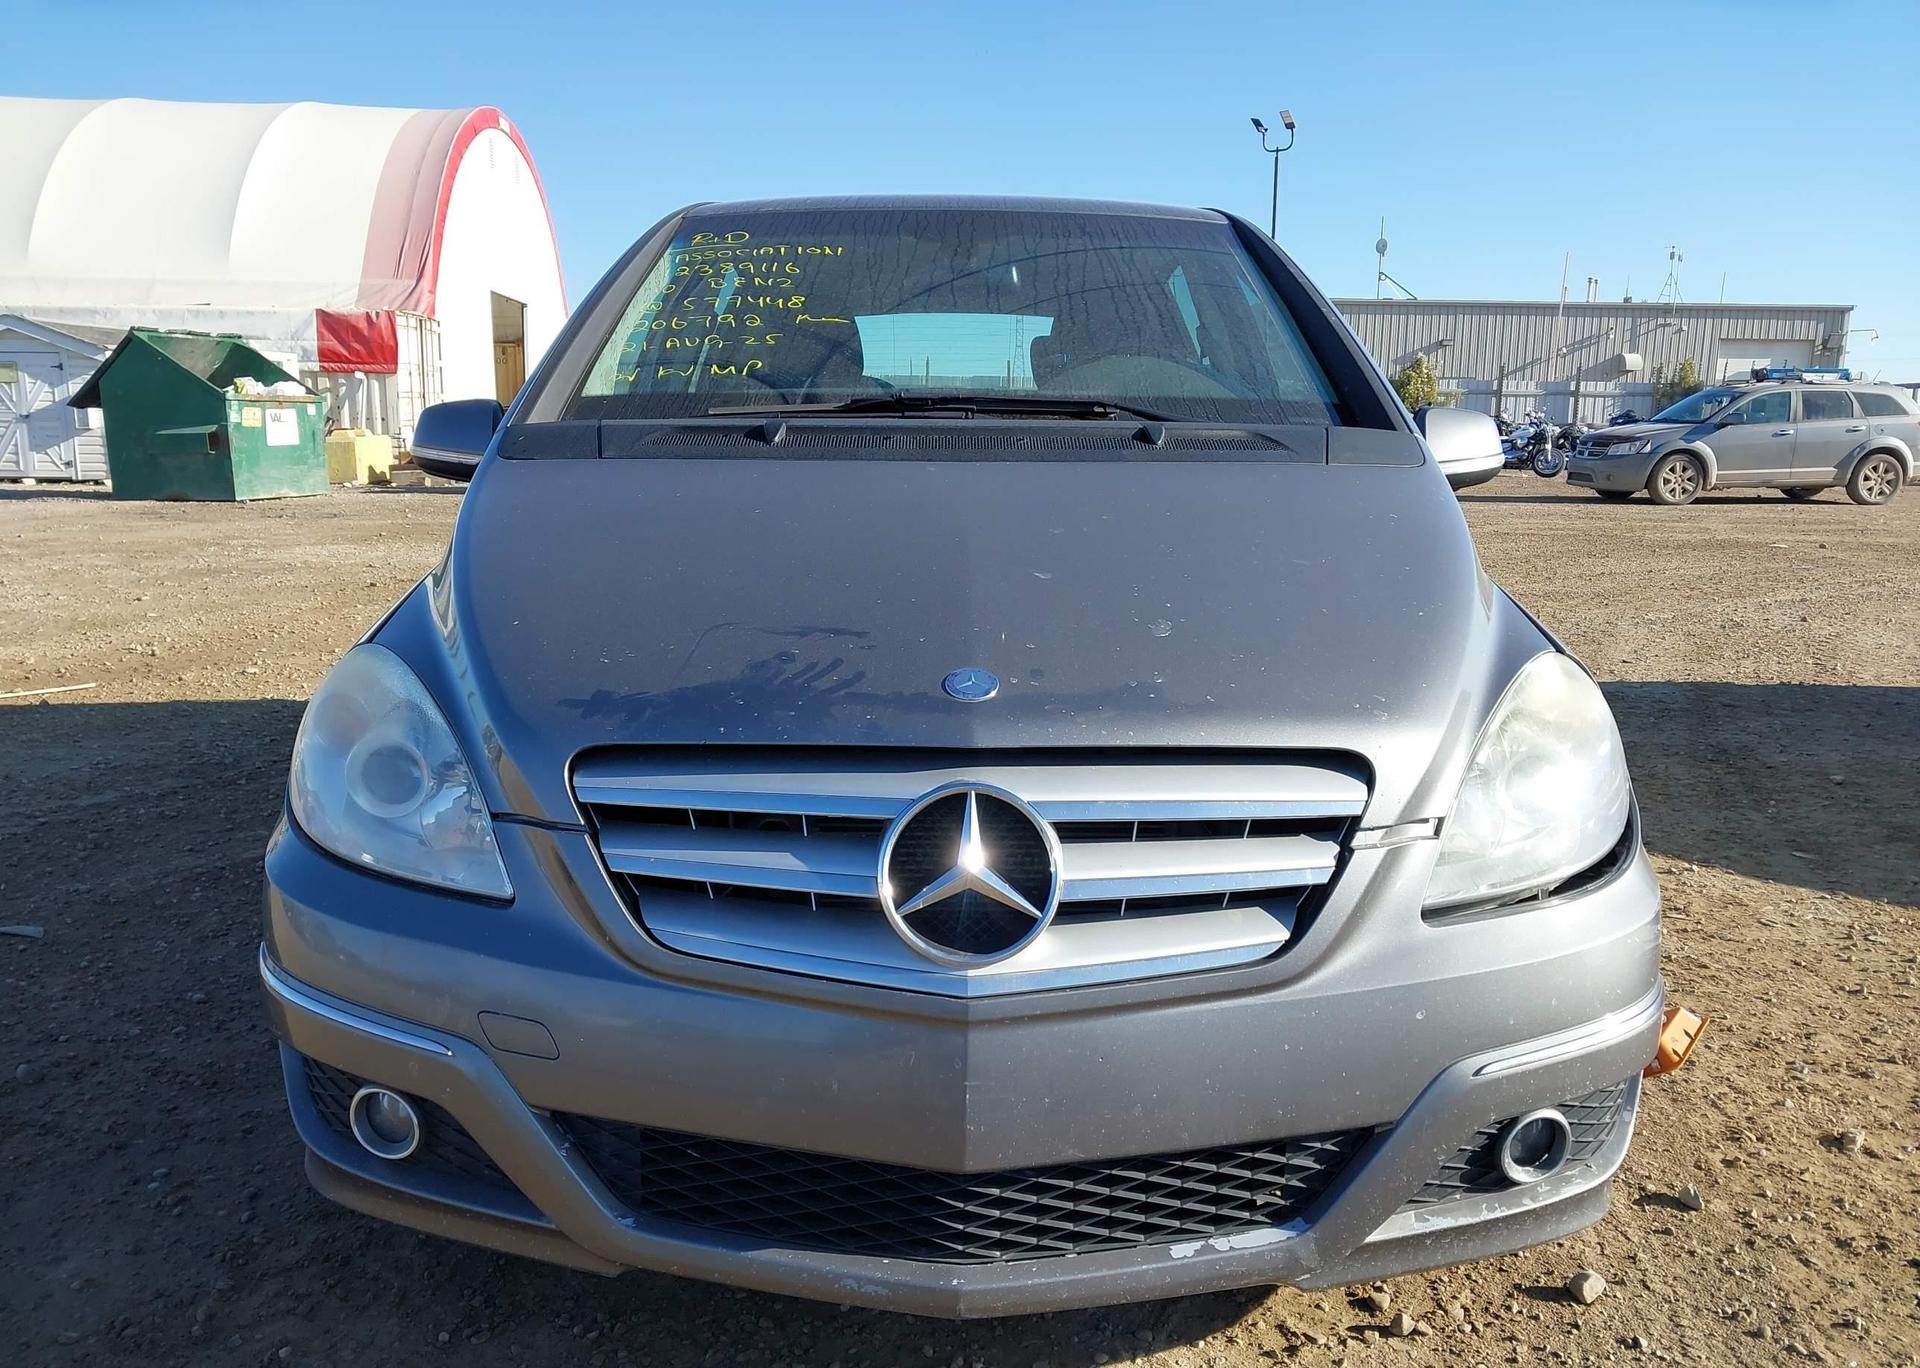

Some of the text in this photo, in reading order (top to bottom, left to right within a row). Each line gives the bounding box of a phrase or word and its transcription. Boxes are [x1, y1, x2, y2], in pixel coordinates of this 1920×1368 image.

[675, 245, 844, 264] ASSOCIATION
[674, 262, 801, 277] 2389116
[682, 295, 806, 311] 577448
[631, 313, 762, 333] 206792
